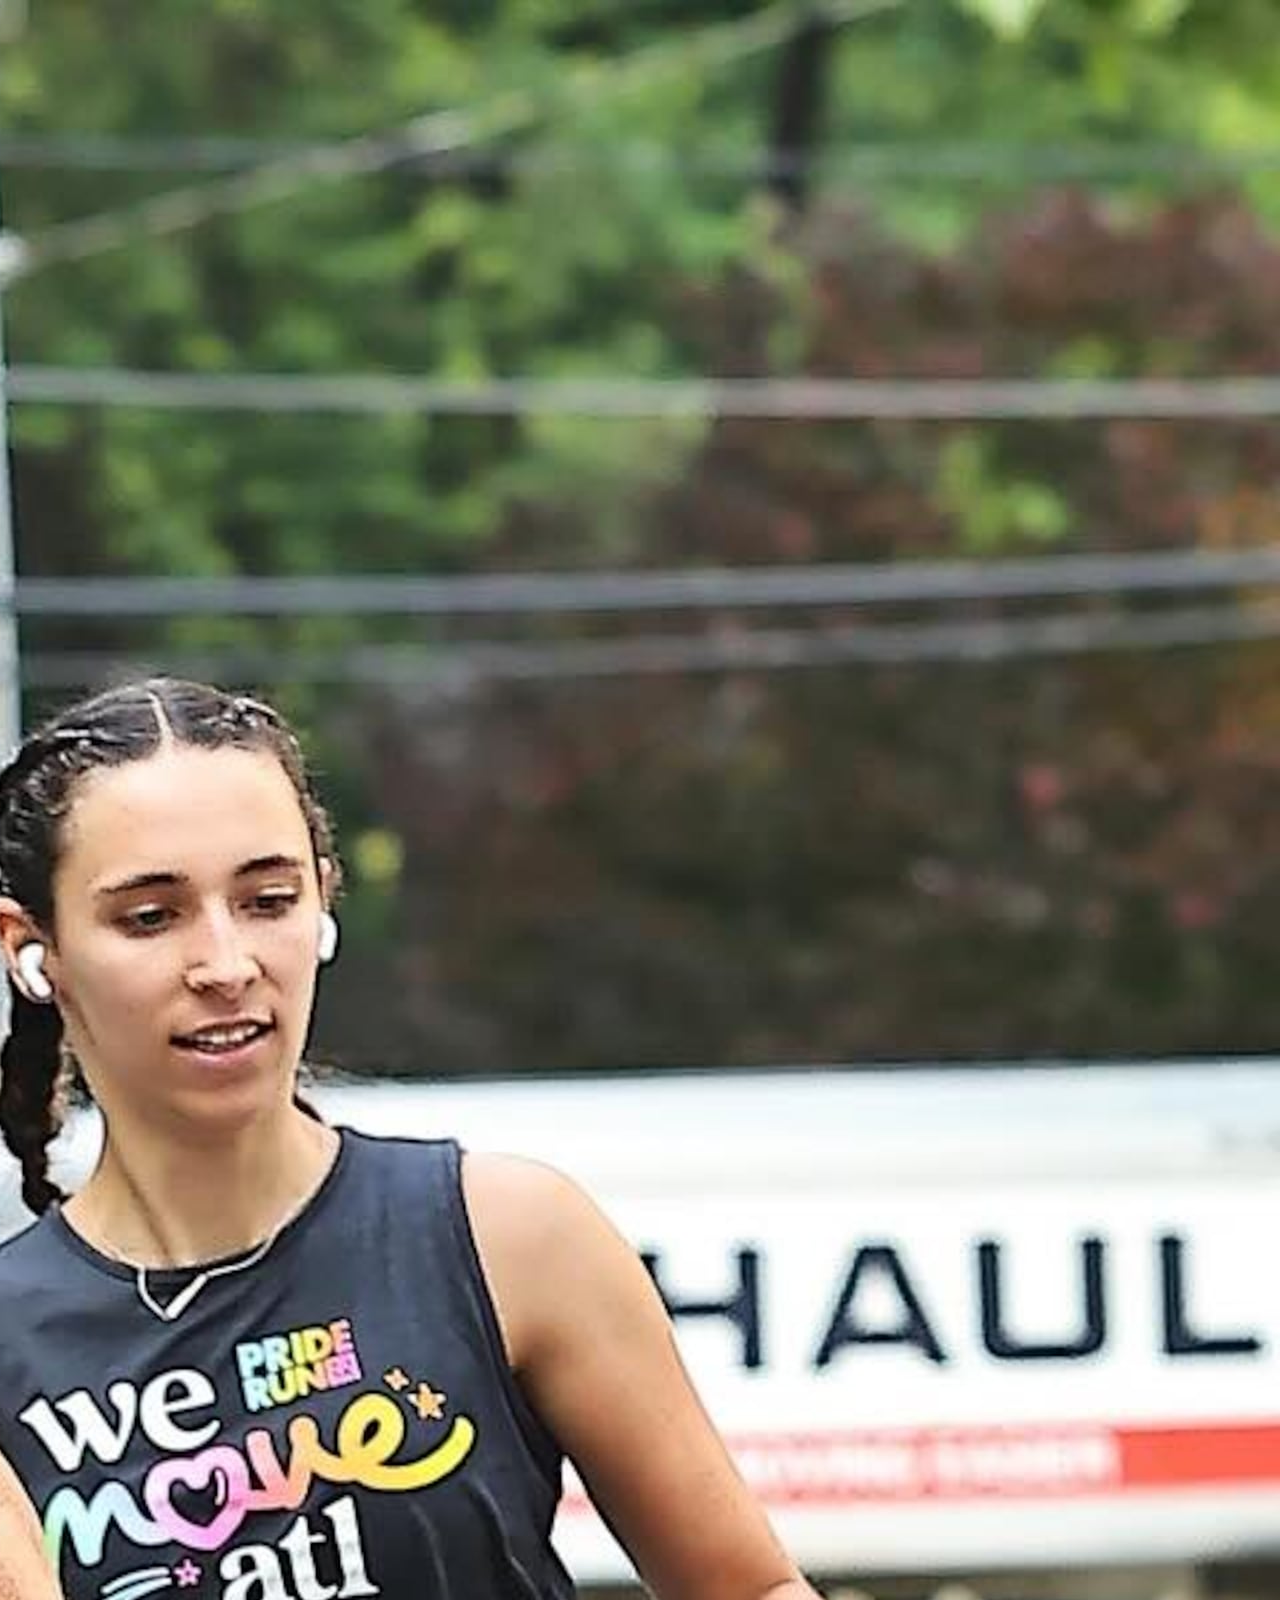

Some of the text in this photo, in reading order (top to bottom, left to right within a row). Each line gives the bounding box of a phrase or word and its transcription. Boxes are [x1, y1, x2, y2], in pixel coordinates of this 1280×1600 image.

[236, 1319, 354, 1378] PRIDE
[640, 1236, 1262, 1368] HAUL
[20, 1368, 220, 1472] we
[244, 1362, 329, 1412] RUN
[44, 1392, 475, 1571] move
